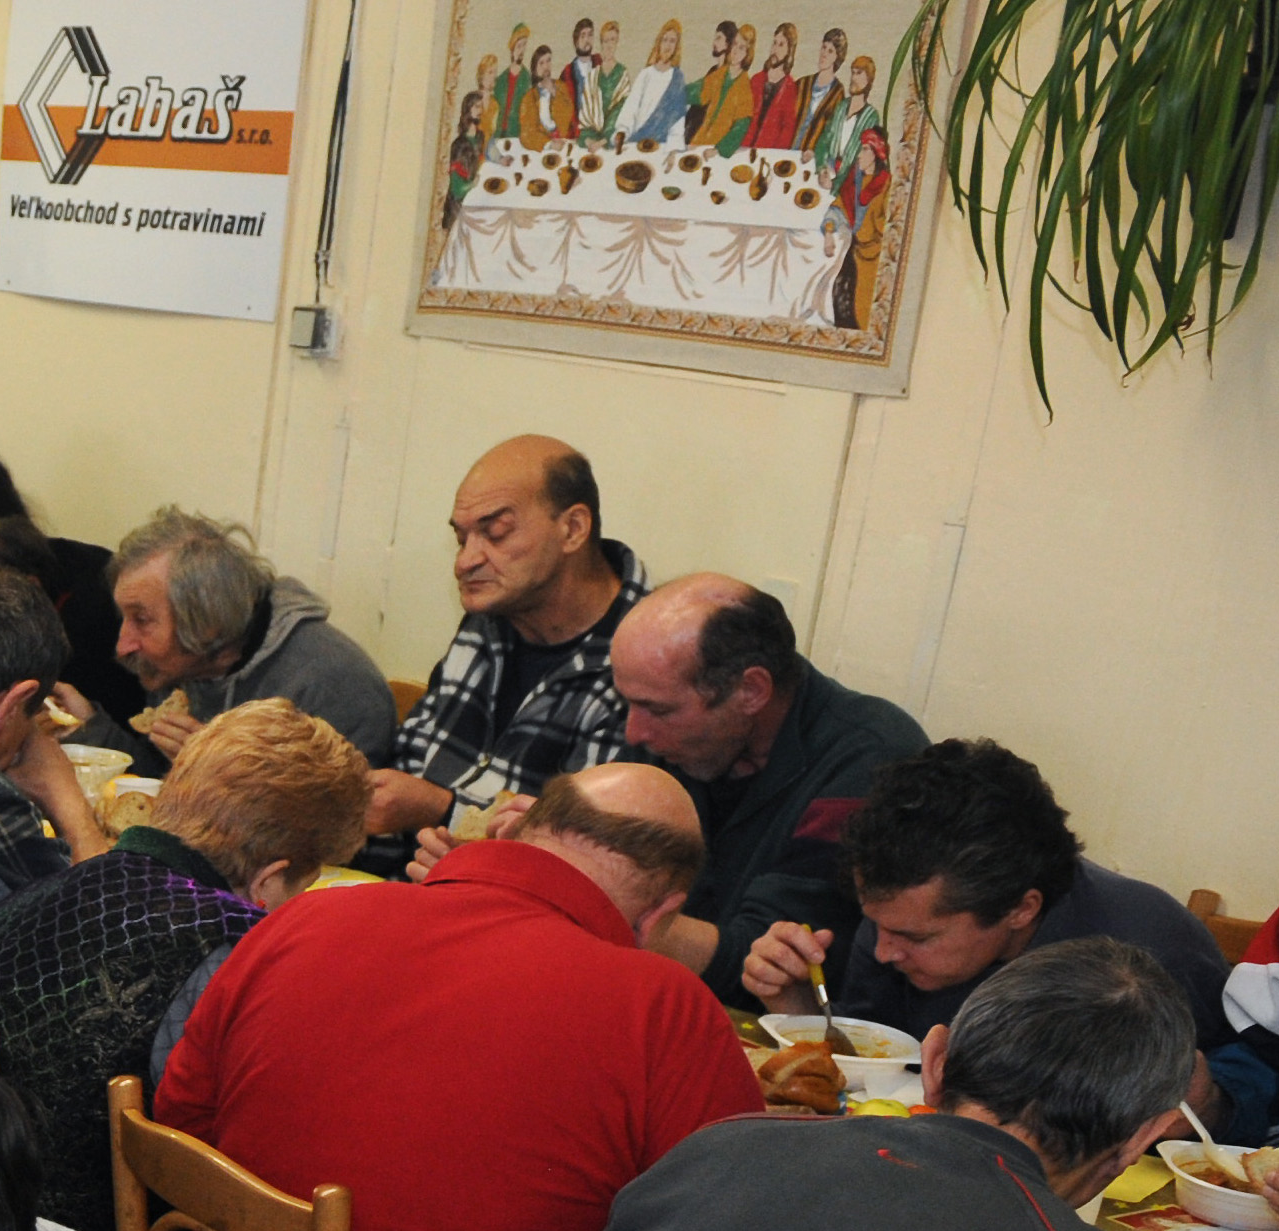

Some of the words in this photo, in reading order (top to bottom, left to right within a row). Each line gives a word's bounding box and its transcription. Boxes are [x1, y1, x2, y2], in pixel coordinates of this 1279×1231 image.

[77, 74, 246, 144] Labaš
[235, 128, 273, 145] s.r.o.
[10, 194, 117, 226] Veľkoobchod
[121, 208, 131, 227] s
[136, 207, 266, 237] potravinami
